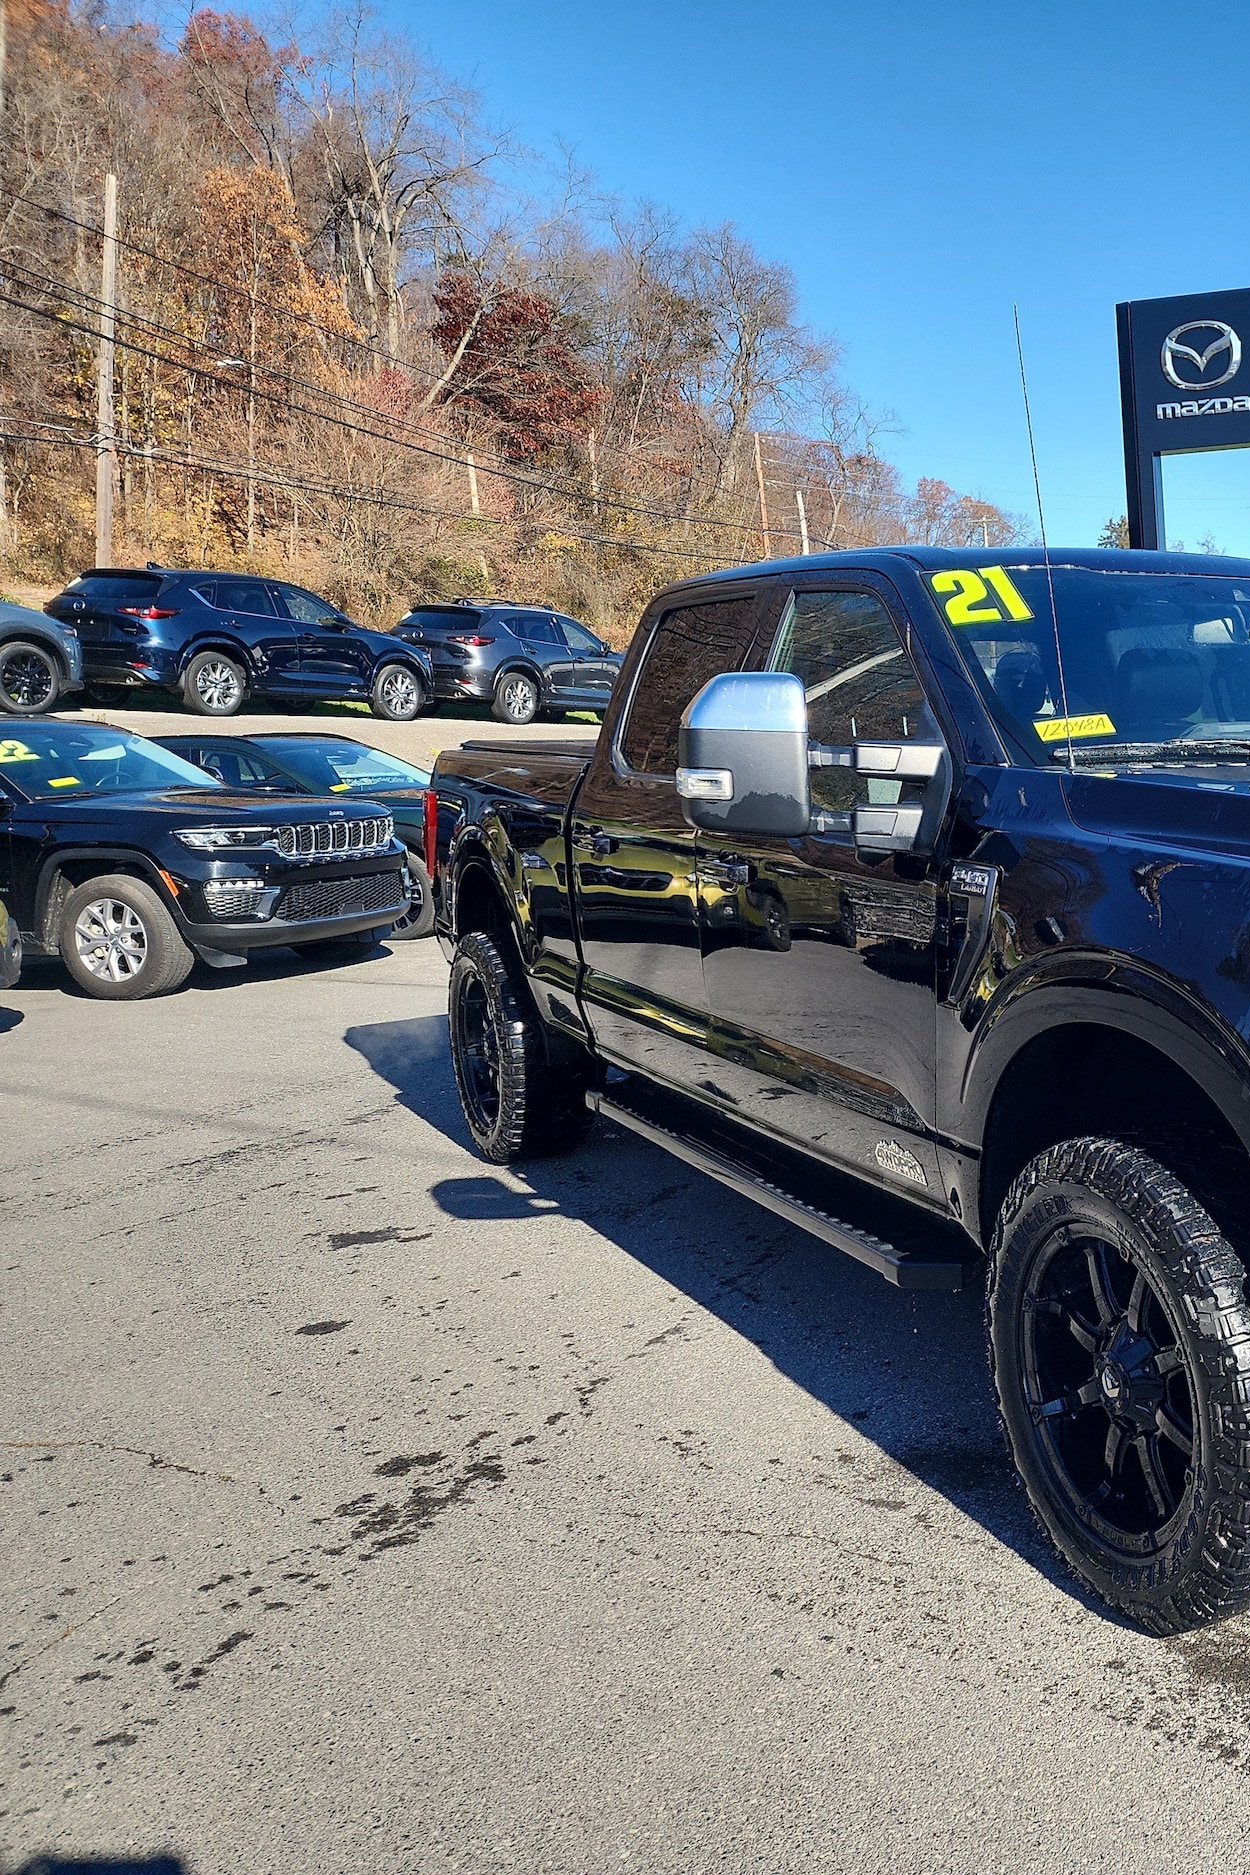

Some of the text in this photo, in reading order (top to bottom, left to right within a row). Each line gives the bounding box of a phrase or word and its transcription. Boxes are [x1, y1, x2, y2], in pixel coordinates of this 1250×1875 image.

[1156, 395, 1250, 419] mazda
[930, 564, 1033, 624] 21
[1041, 716, 1106, 738] 12048A
